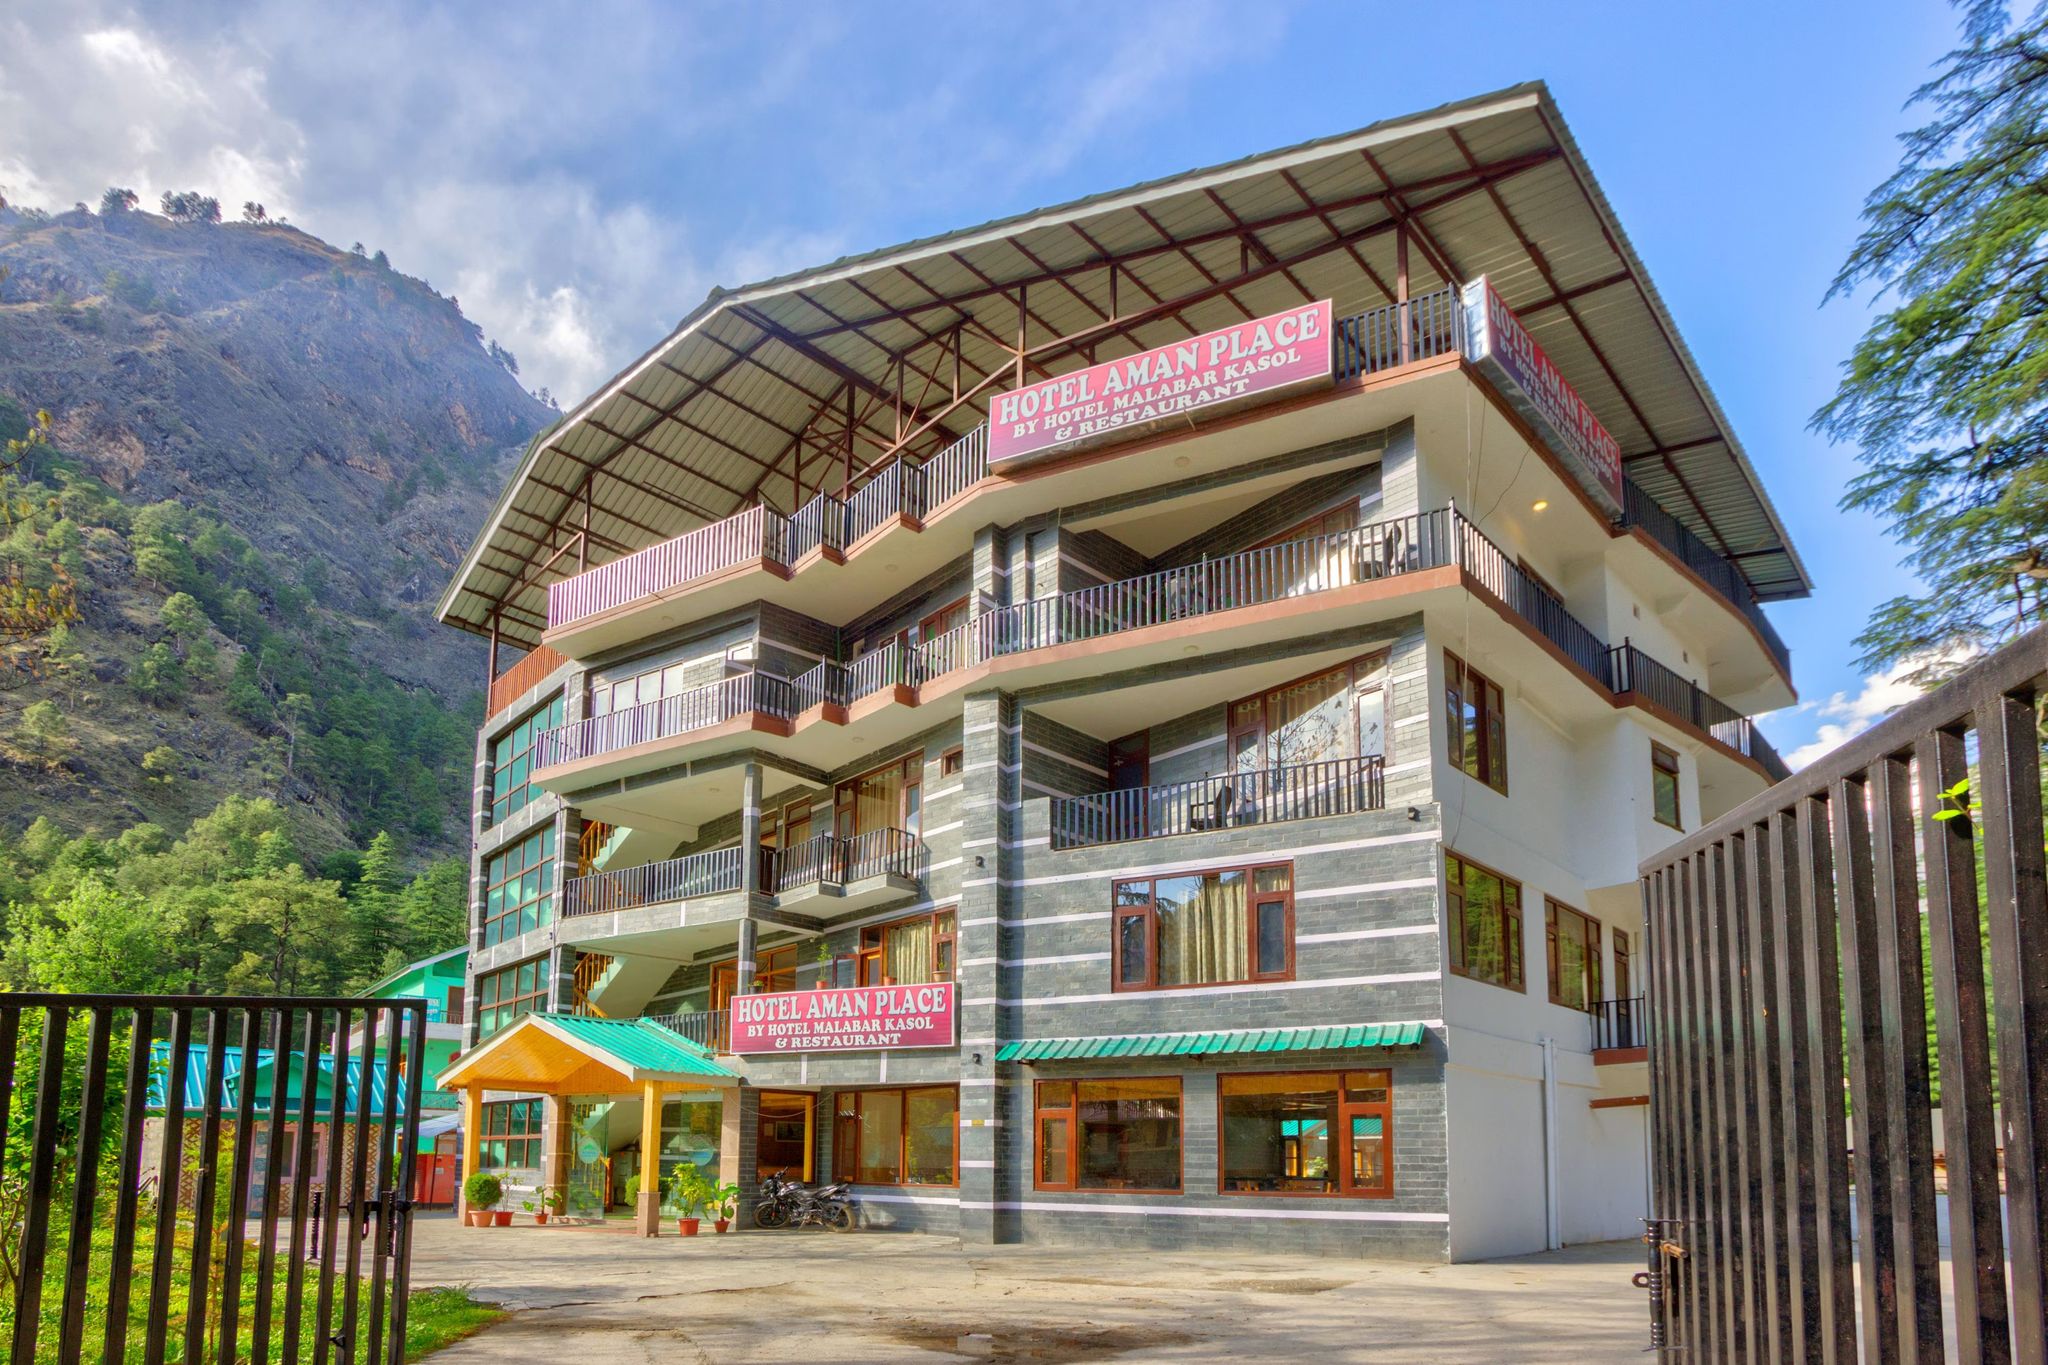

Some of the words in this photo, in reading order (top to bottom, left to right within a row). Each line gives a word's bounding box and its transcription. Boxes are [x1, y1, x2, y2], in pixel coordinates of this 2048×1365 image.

[999, 374, 1095, 425] HOTEL
[1101, 342, 1201, 397] AMAN
[1208, 308, 1321, 367] PLACE
[1012, 419, 1039, 439] BY
[1043, 397, 1108, 430] HOTEL
[1113, 371, 1217, 411] MALABAR
[1223, 348, 1301, 379] KASOL
[1490, 291, 1538, 374] HOTEL
[1541, 359, 1579, 422] AMAN
[1581, 405, 1619, 473] PLACE
[1500, 336, 1513, 361] BY
[1516, 355, 1546, 398] HOTEL
[1054, 425, 1072, 441] &
[1078, 378, 1250, 436] RESTAURANT
[738, 996, 802, 1023] HOTEL
[806, 991, 870, 1019] AMAN
[875, 987, 946, 1017] PLACE
[747, 1025, 763, 1038] BY
[767, 1023, 810, 1036] HOTEL
[813, 1019, 881, 1035] MALABAR
[884, 1017, 934, 1030] KASOL
[775, 1038, 787, 1048] &
[790, 1033, 901, 1048] RESTAURANT
